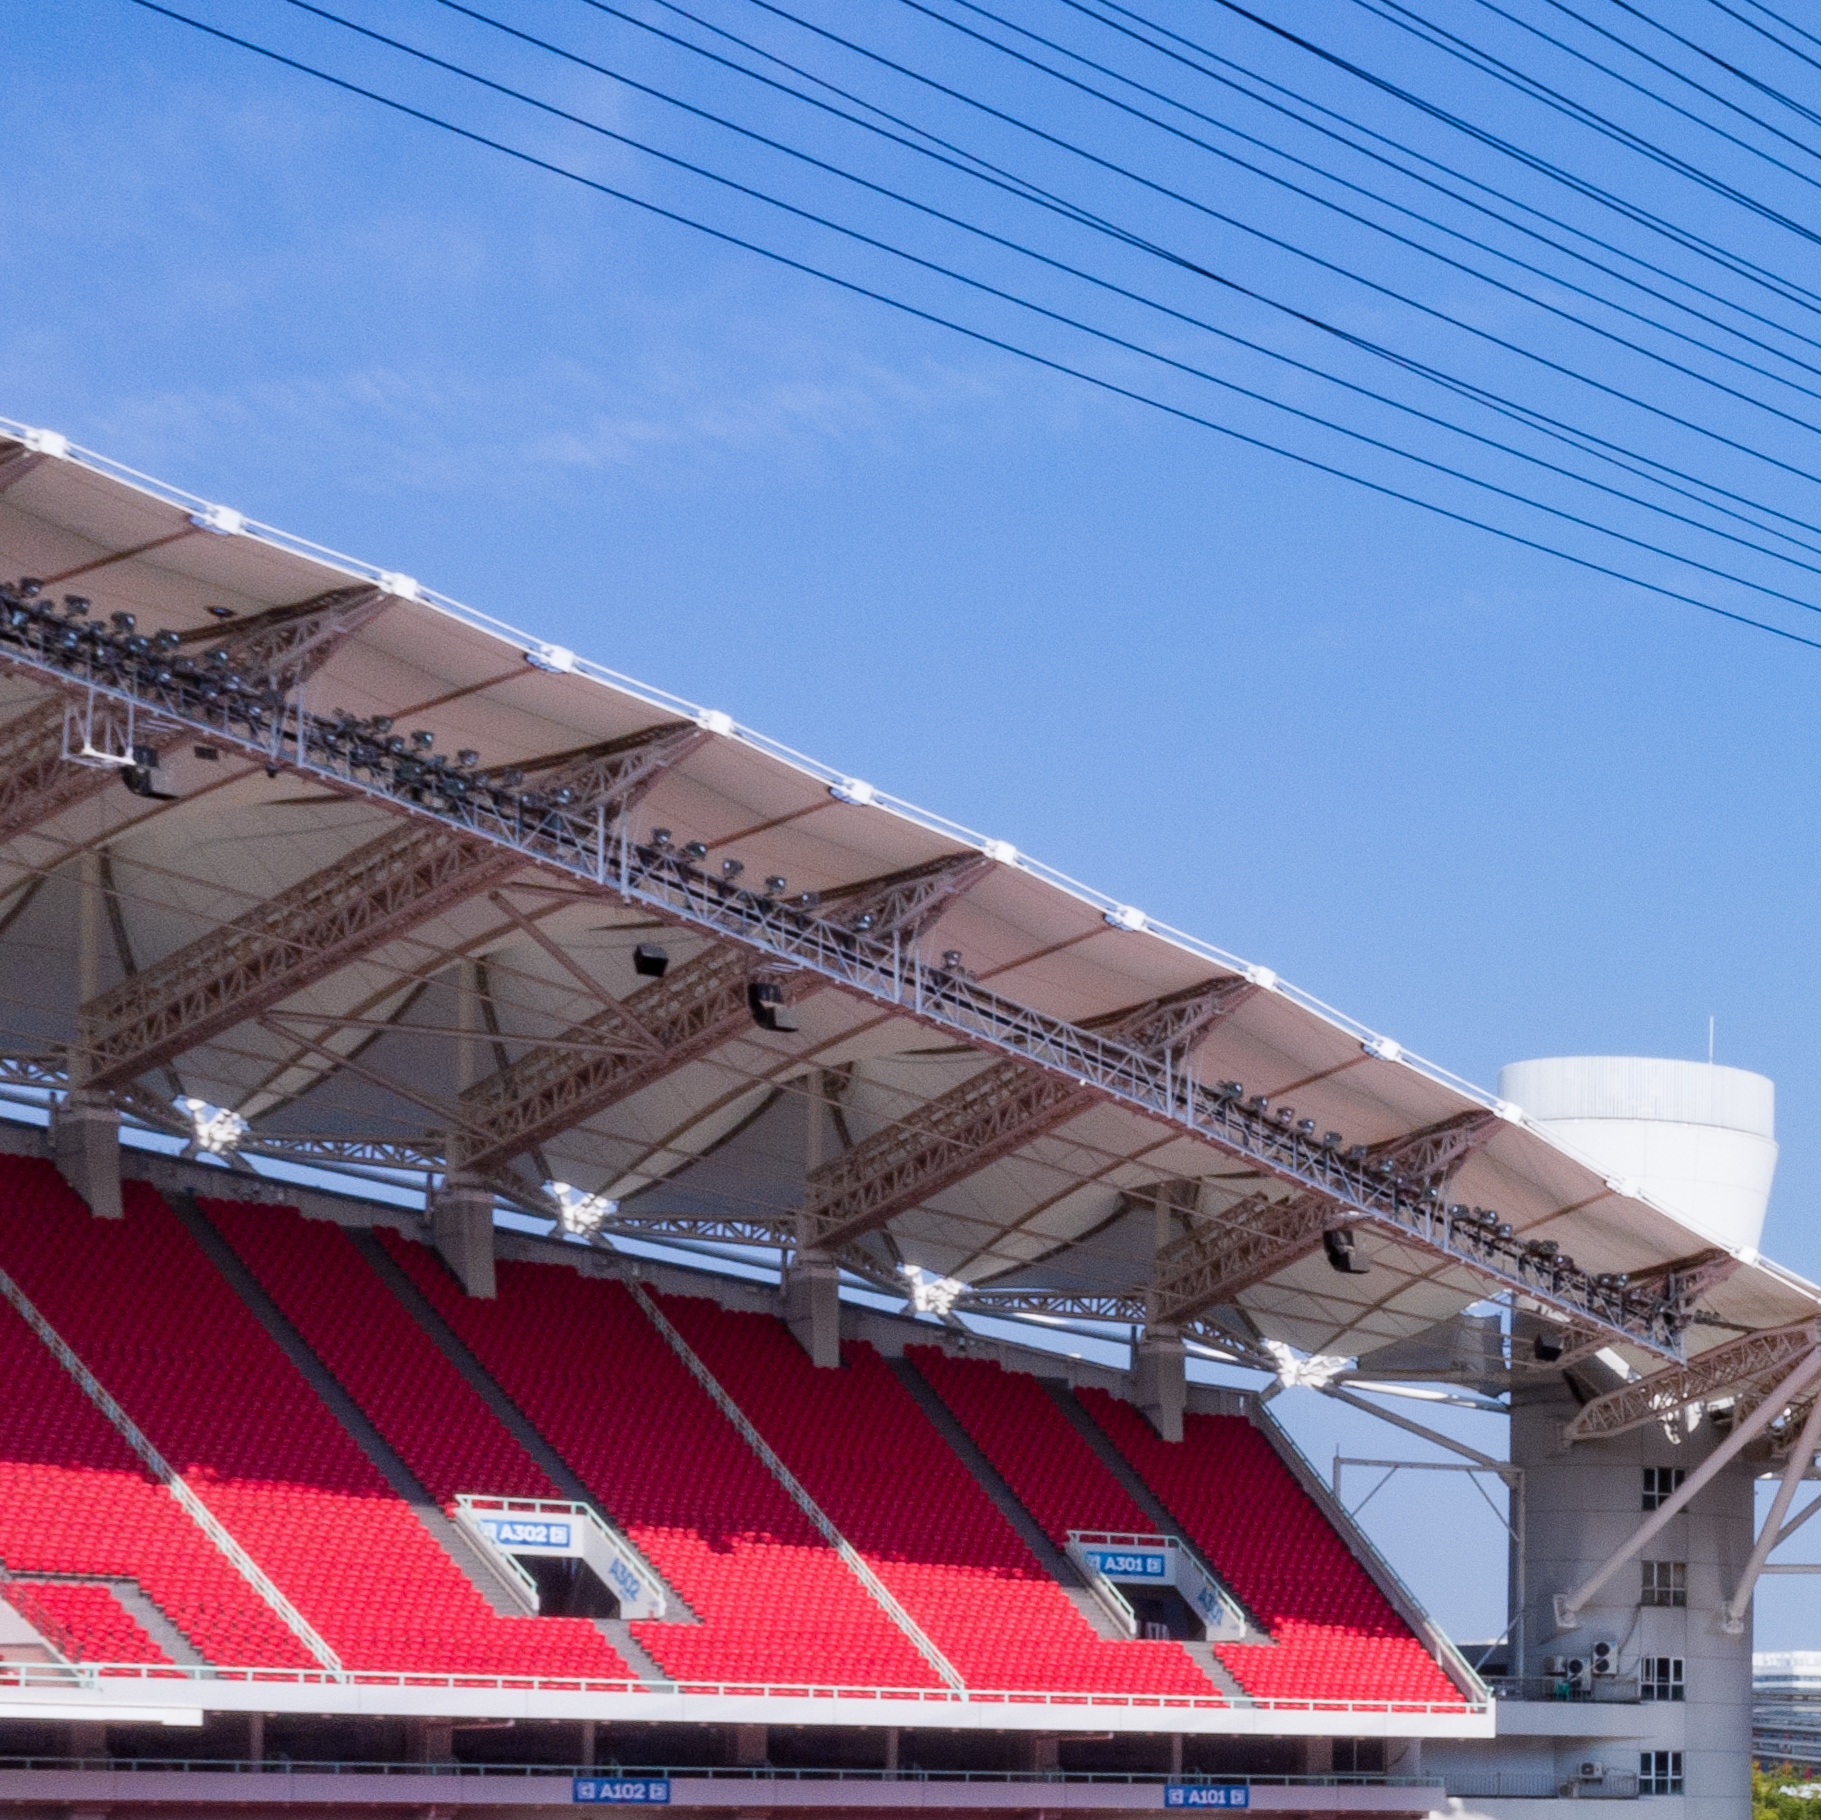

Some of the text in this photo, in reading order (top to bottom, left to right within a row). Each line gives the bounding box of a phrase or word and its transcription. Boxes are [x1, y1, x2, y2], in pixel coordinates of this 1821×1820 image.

[499, 1524, 547, 1543] A302
[1104, 1556, 1143, 1573] A301
[608, 1557, 640, 1602] A302
[600, 1785, 645, 1799] A102
[1188, 1791, 1225, 1804] A101
